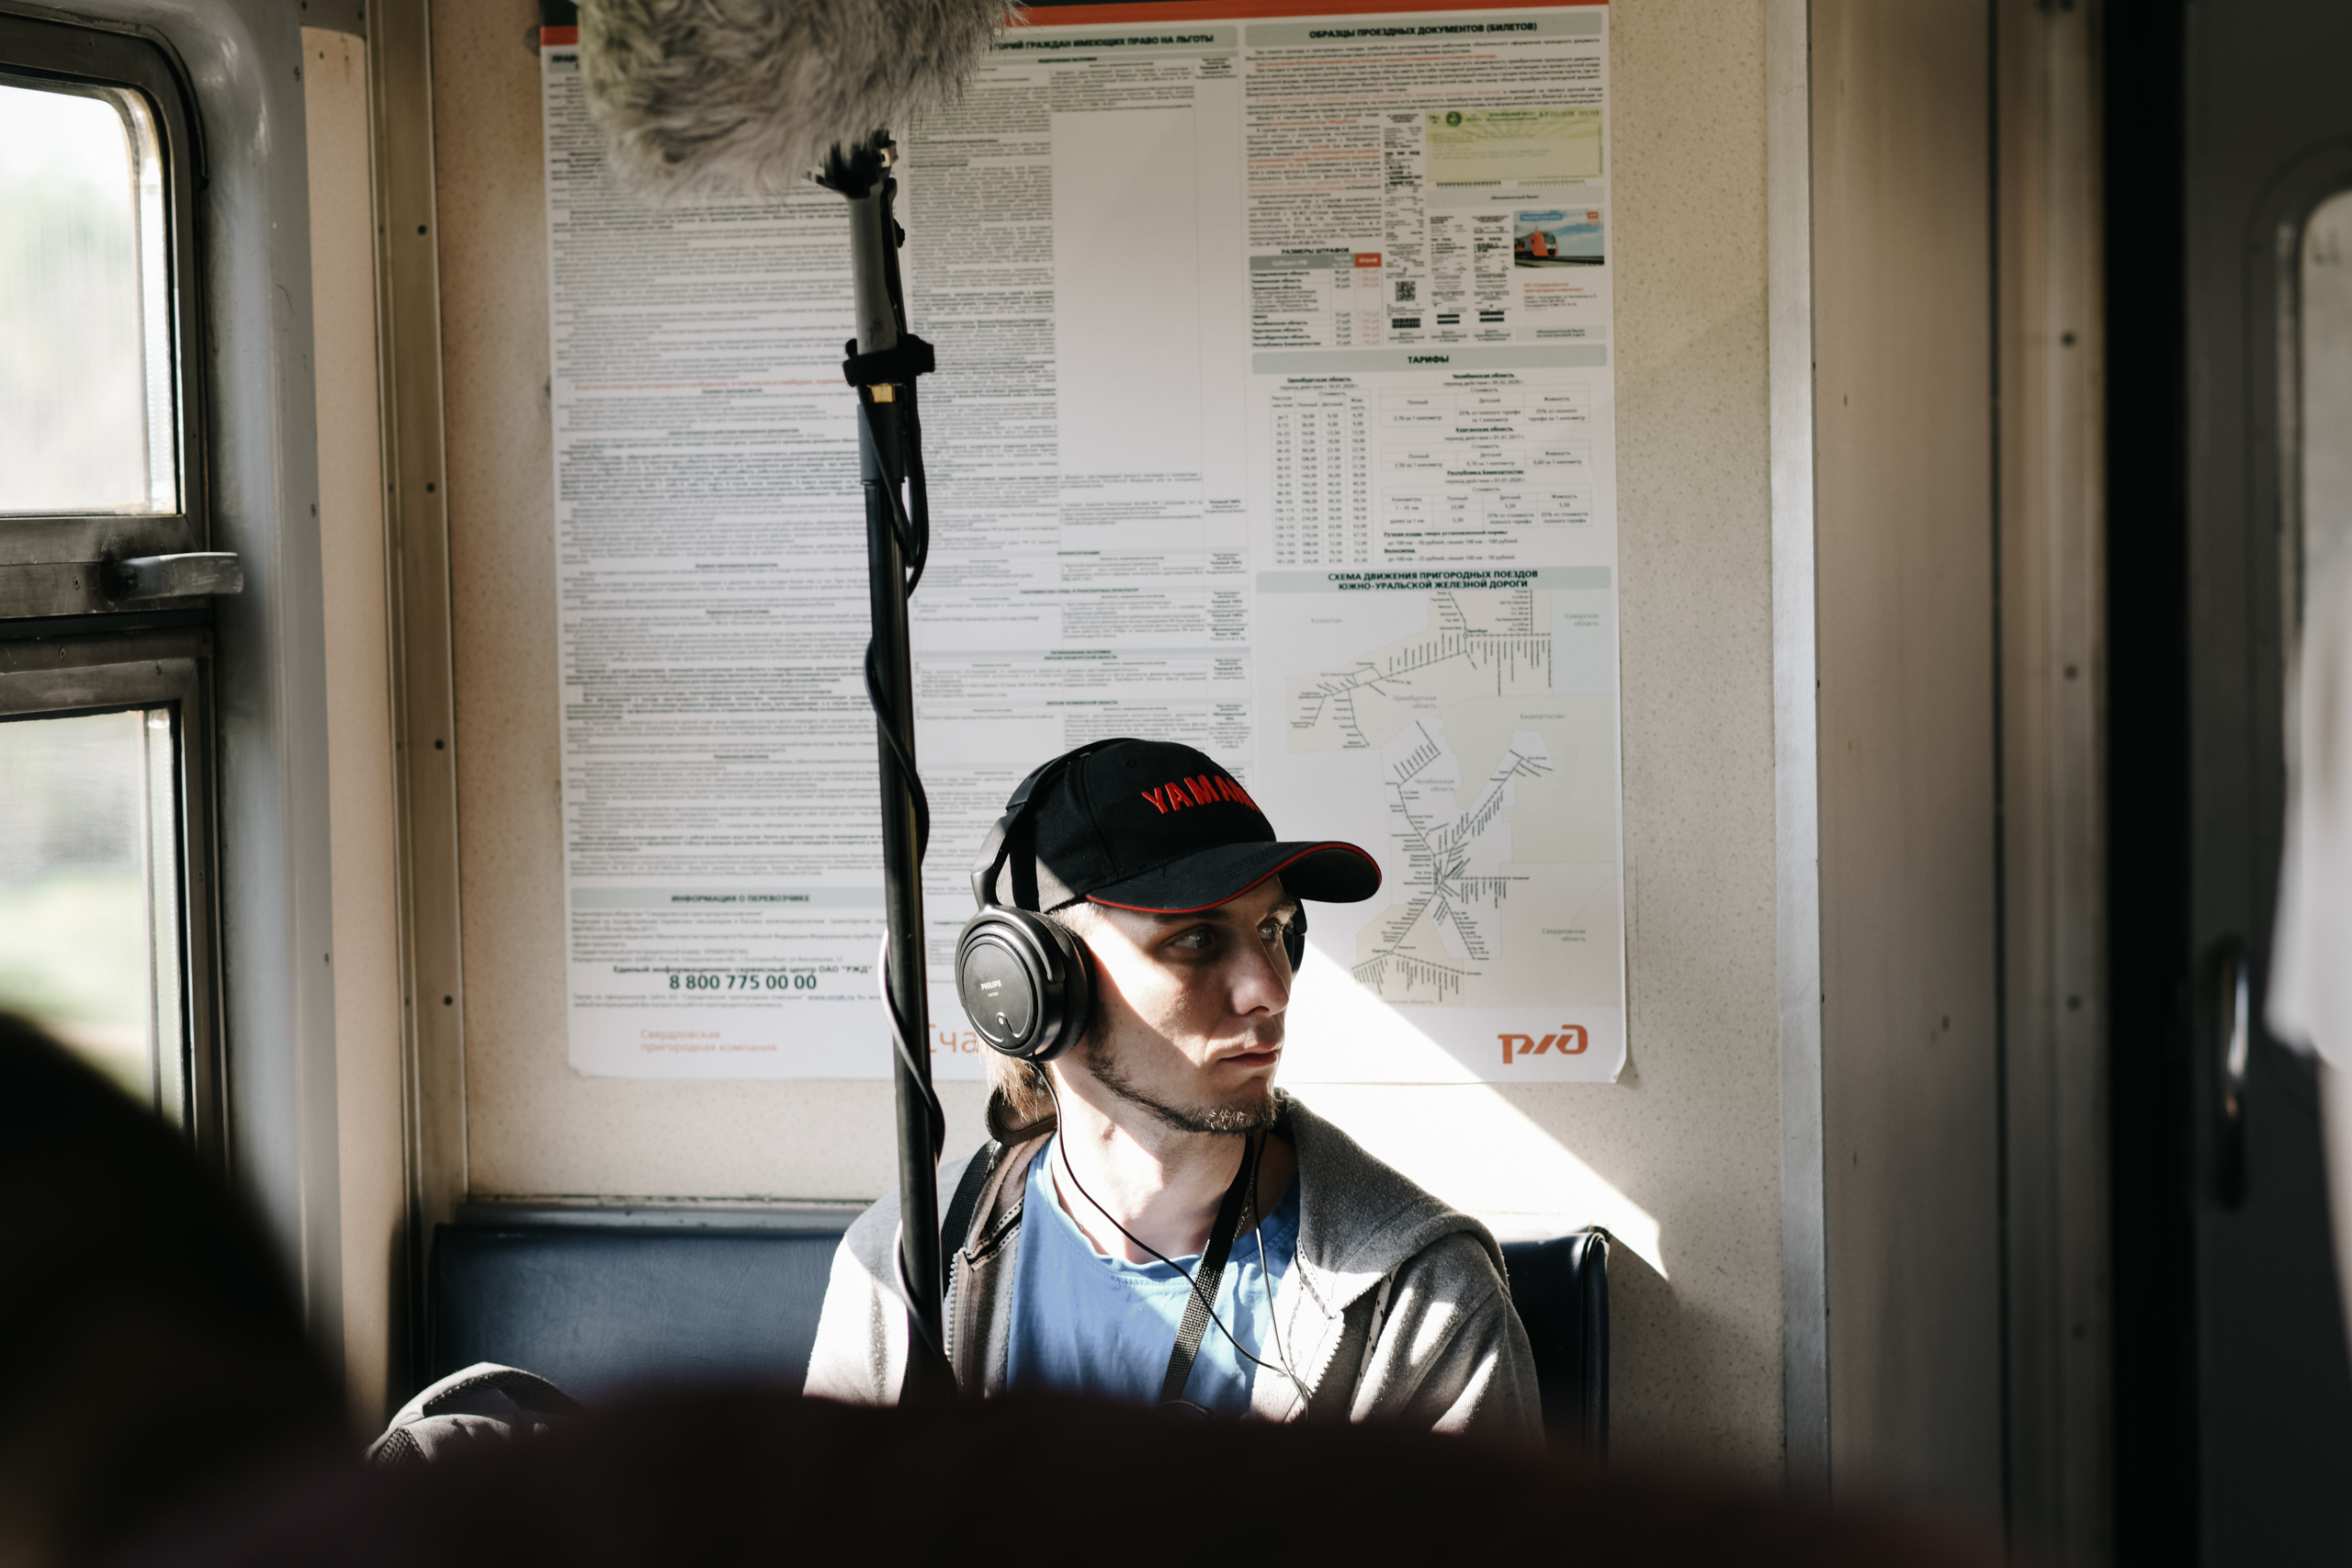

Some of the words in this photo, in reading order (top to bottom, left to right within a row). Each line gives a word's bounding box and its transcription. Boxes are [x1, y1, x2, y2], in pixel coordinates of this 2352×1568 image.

[1310, 29, 1355, 39] ОБРАЗЦЫ
[1357, 27, 1414, 37] ПРОЕЗДНЫХ
[1418, 25, 1483, 35] ДОКУМЕНТОВ
[1487, 22, 1536, 33] (БИЛЕТОВ)
[1026, 40, 1070, 50] ГРАЖДАН
[1074, 39, 1124, 48] ИМЕЮЩИХ
[1176, 34, 1213, 43] ЛЬГОТЫ
[1407, 355, 1450, 364] ТАРИФЫ
[1364, 572, 1417, 581] ДВИЖЕНИЯ
[1420, 571, 1491, 579] ПРИГОРОДНЫХ
[1494, 570, 1538, 579] ПОЕЗДОВ
[1339, 581, 1432, 590] ЮЖНО-УРАЛЬСКОЙ
[1436, 580, 1486, 589] ЖЕЛЕЗНОЙ
[1489, 580, 1527, 589] ДОРОГИ
[613, 965, 649, 974] Единый
[652, 965, 786, 974] информационно-сервисный
[841, 966, 872, 974] "РЖД"
[670, 974, 679, 989] 8
[686, 974, 719, 989] 800
[727, 974, 760, 989] 775
[766, 974, 788, 989] 00
[795, 974, 816, 989] 00
[980, 980, 1002, 990] PHILIPS
[641, 1029, 720, 1040] Свердловская
[641, 1043, 716, 1054] пригородная
